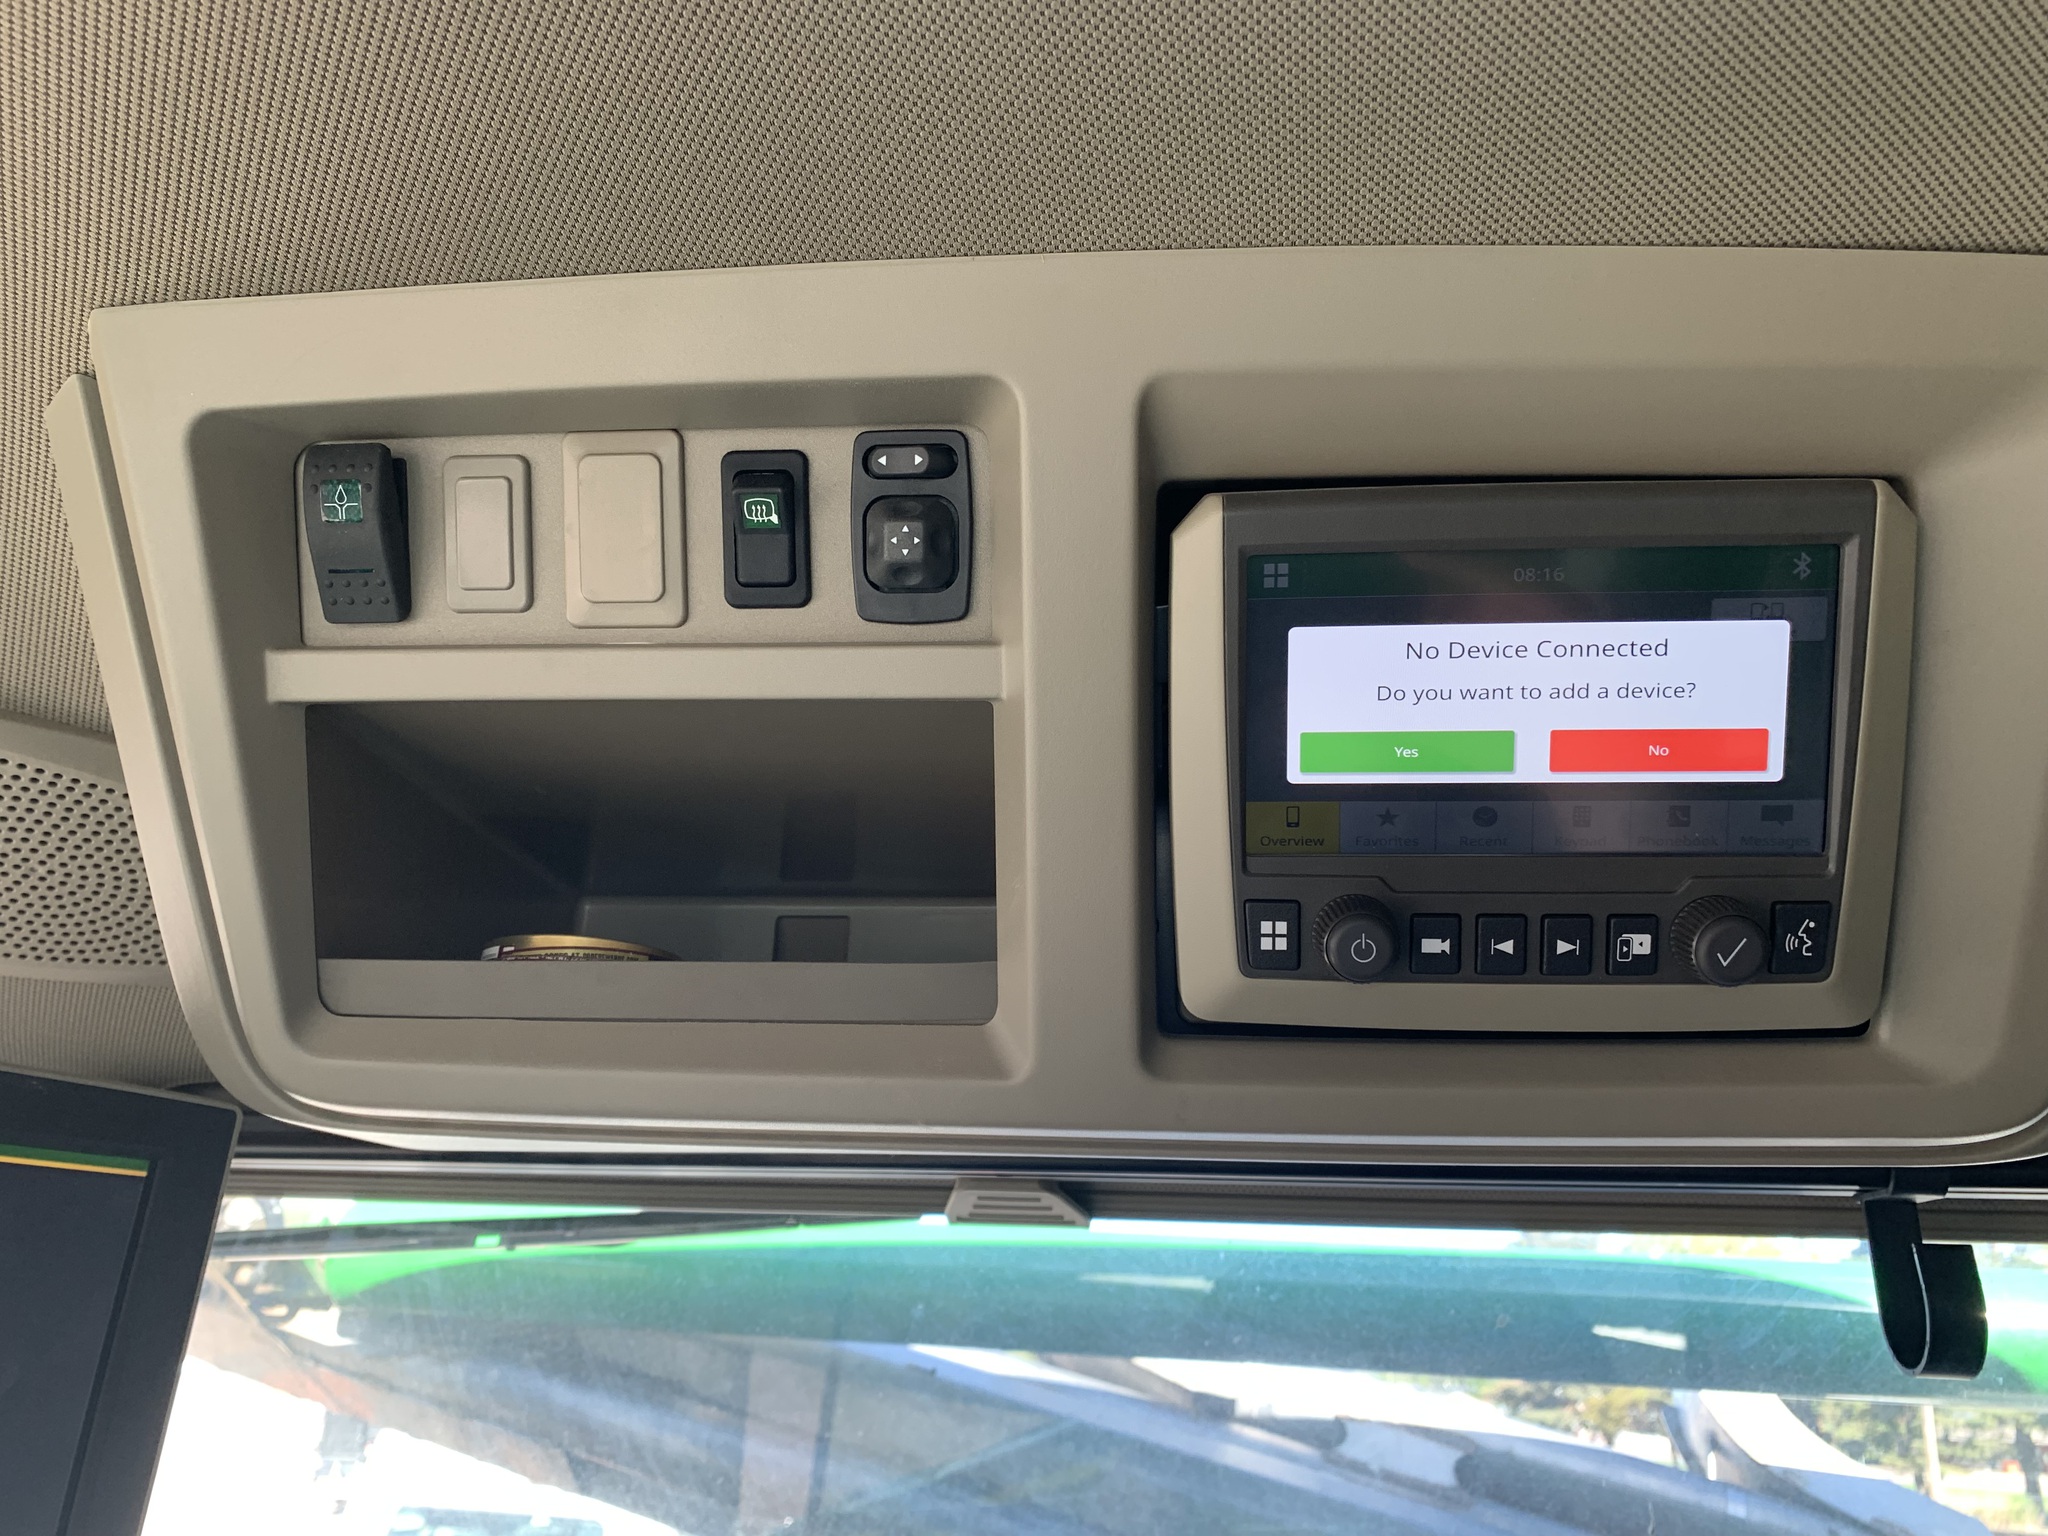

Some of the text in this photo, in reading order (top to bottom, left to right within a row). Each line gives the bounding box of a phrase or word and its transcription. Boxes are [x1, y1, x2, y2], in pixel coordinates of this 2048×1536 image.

[1513, 567, 1566, 583] 08:16
[1406, 638, 1668, 660] No Device Connected
[1377, 682, 1696, 706] Do you want to add a device?
[1394, 746, 1419, 758] Yes
[1648, 744, 1670, 756] No
[1260, 835, 1325, 847] Overview
[1355, 835, 1420, 847] Favorites
[1458, 835, 1508, 847] Recent
[1554, 836, 1608, 848] Keypad
[1638, 835, 1720, 847] Phonebook
[1739, 835, 1812, 848] Messages
